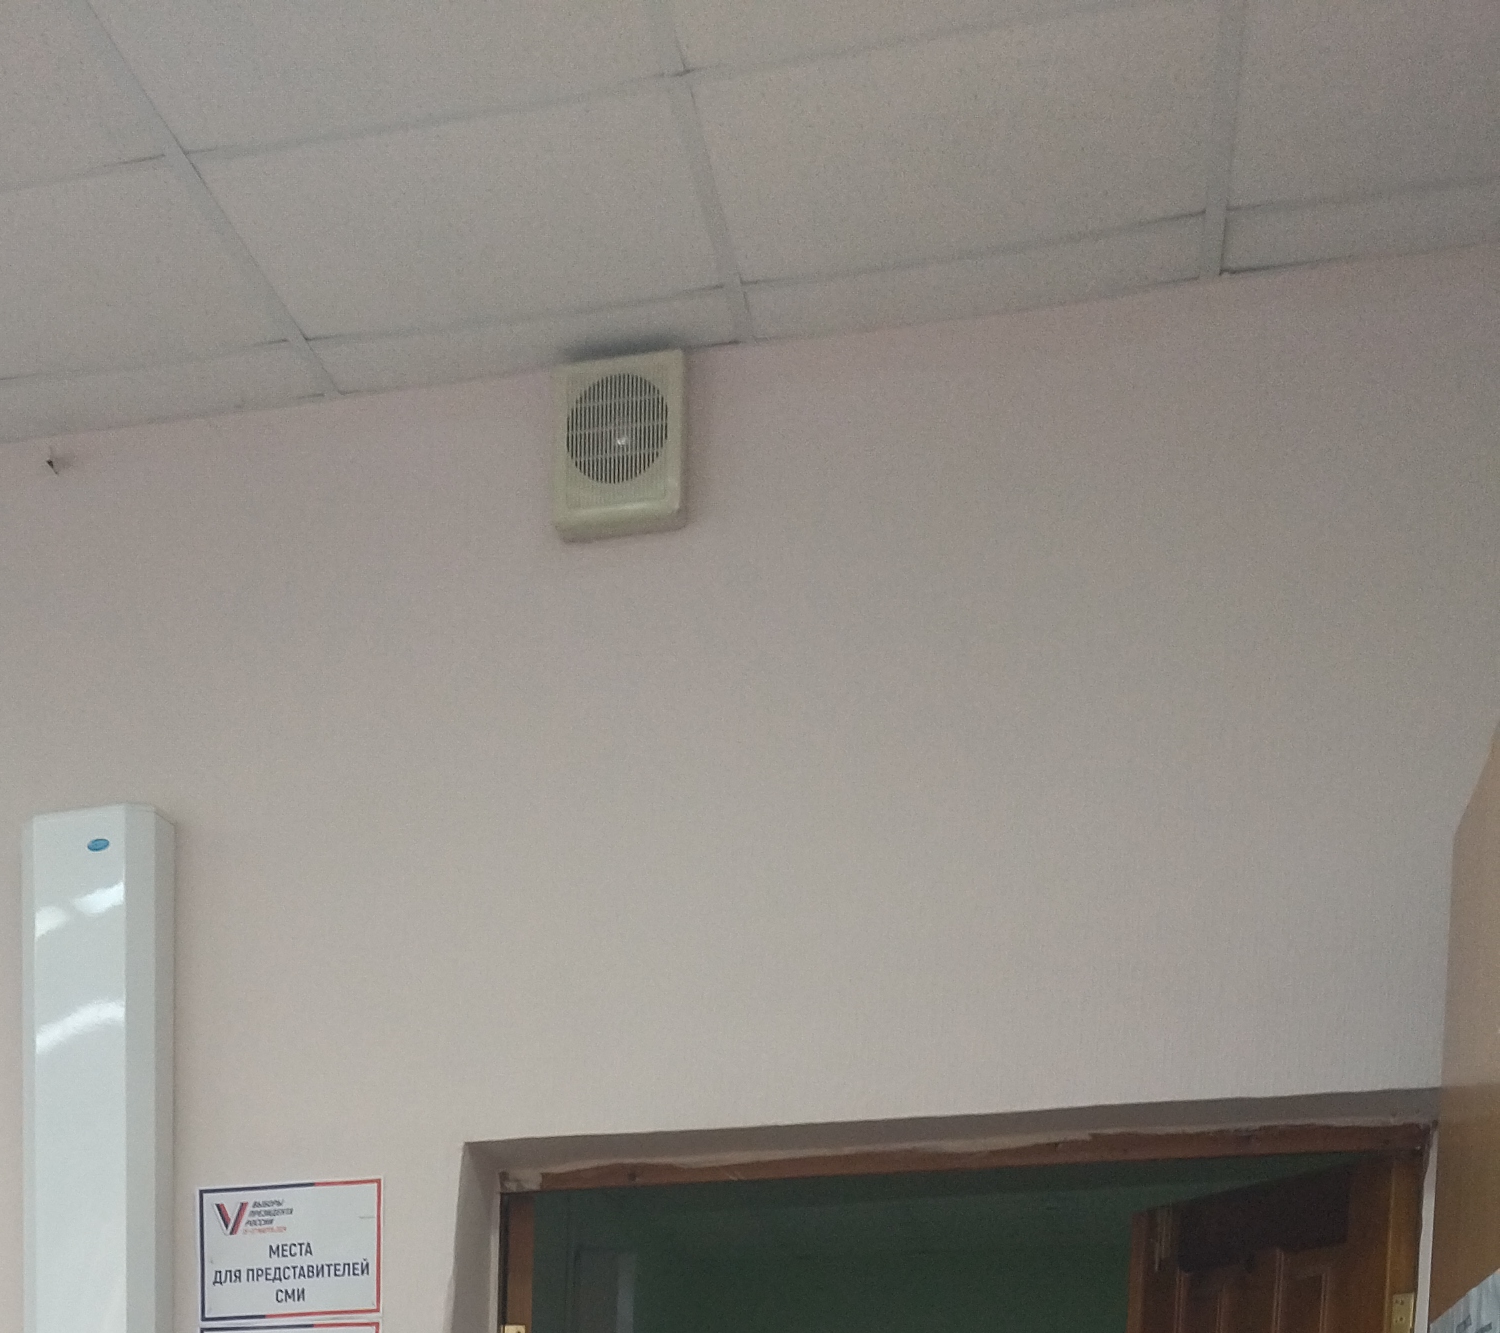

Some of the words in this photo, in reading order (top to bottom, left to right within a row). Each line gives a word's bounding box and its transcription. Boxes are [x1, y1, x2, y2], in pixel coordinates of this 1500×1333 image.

[268, 1242, 313, 1259] МЕСТА
[213, 1269, 242, 1285] ДЛЯ
[246, 1259, 369, 1284] ПРЕДСТАВИТЕЛЕЙ
[275, 1288, 305, 1303] СМИ
